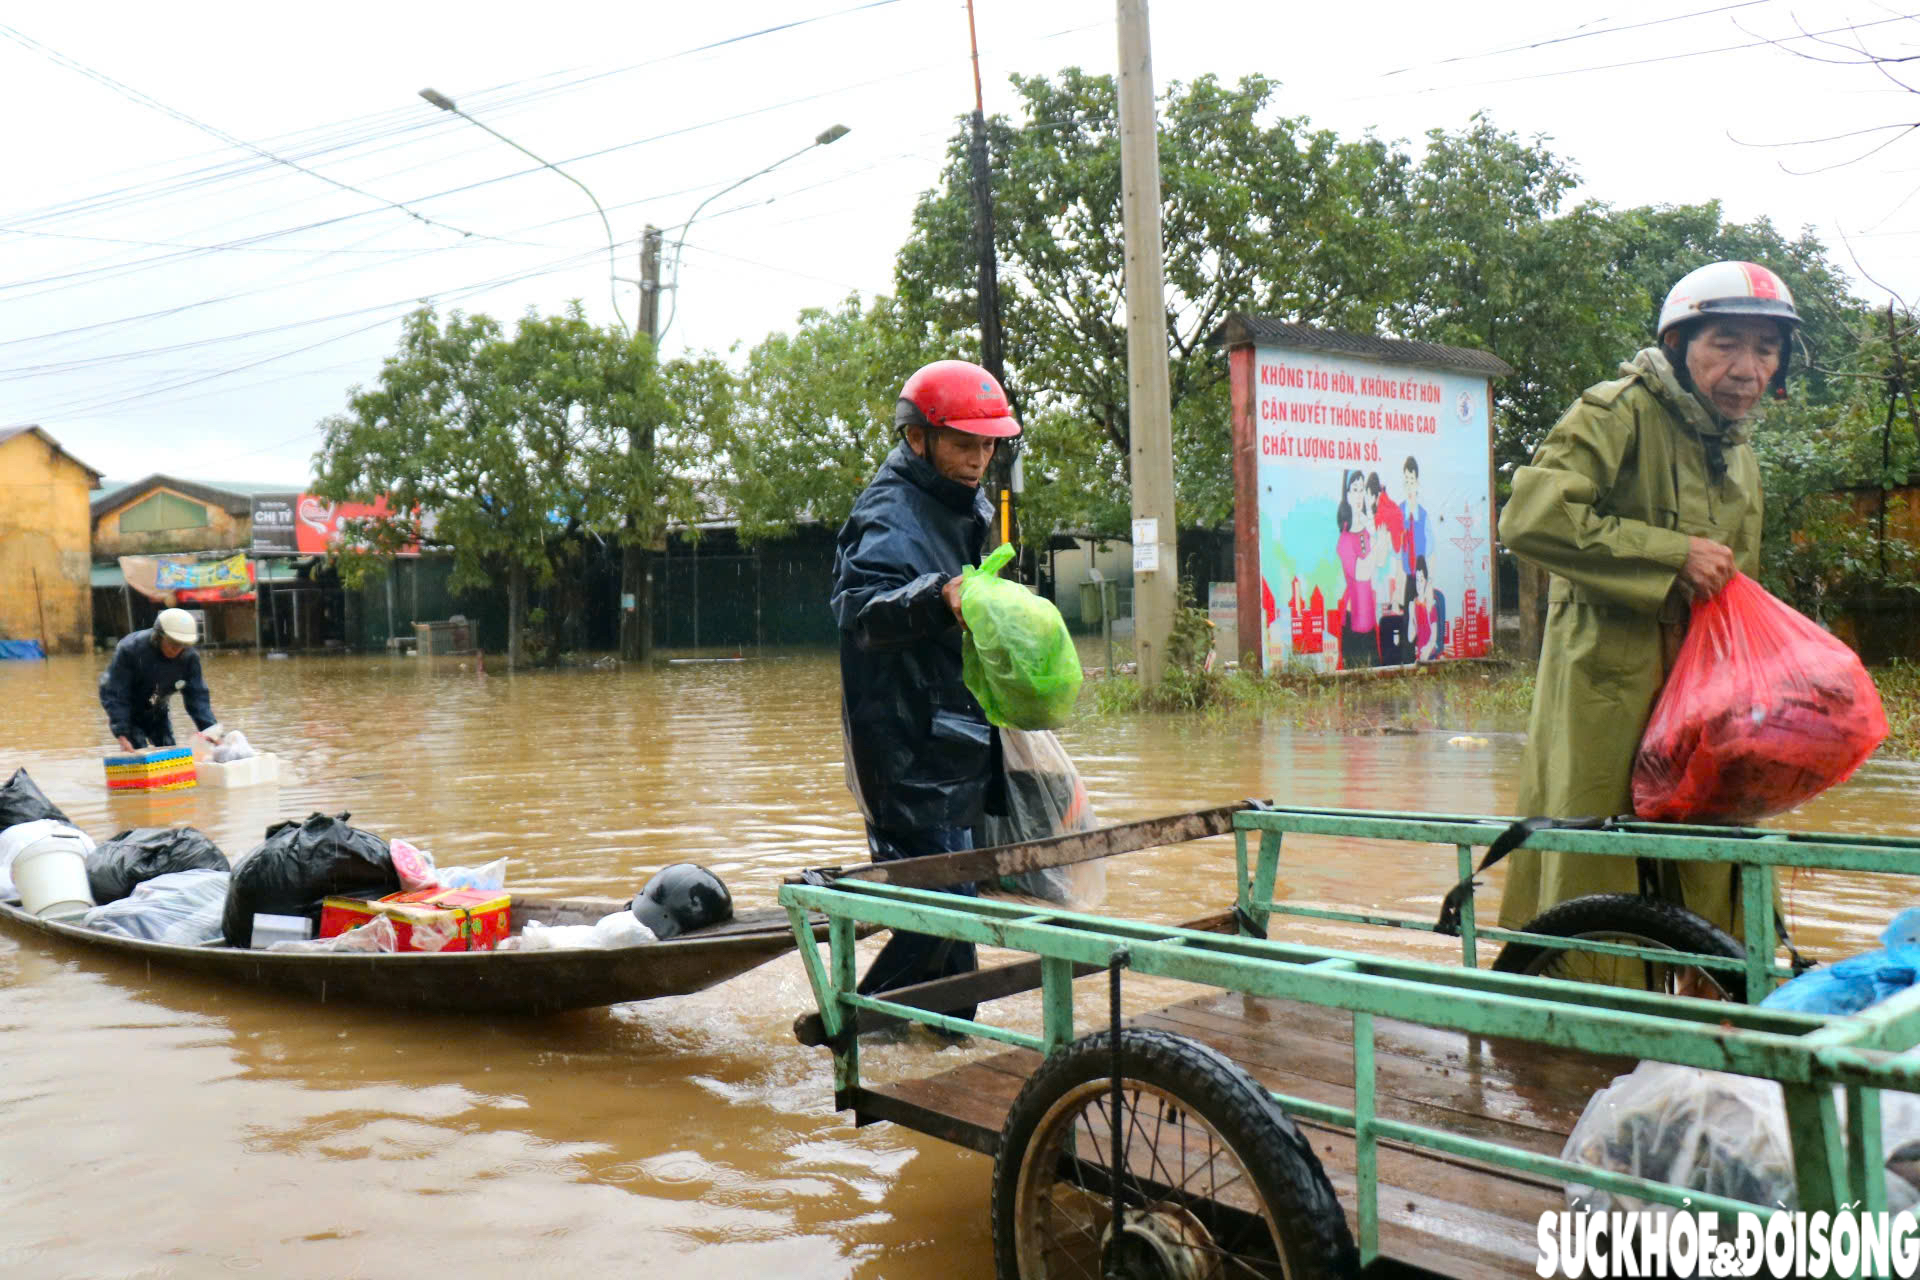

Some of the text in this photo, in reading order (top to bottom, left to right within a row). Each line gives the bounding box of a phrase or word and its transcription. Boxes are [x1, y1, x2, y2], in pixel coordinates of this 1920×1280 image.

[1261, 362, 1441, 404] KHÔNG TẢO HÔN, KHÔNG KẾT HÔN
[1261, 396, 1287, 425] CẬN
[1290, 399, 1328, 425] HUYẾT
[1330, 400, 1366, 429] THỐNG
[1385, 409, 1414, 433] NÂNG
[1416, 415, 1437, 435] CAO
[1262, 429, 1294, 457] CHẤT
[1297, 436, 1335, 463] LƯỢNG
[1338, 437, 1361, 462] DÂN
[254, 511, 277, 525] CHỊ
